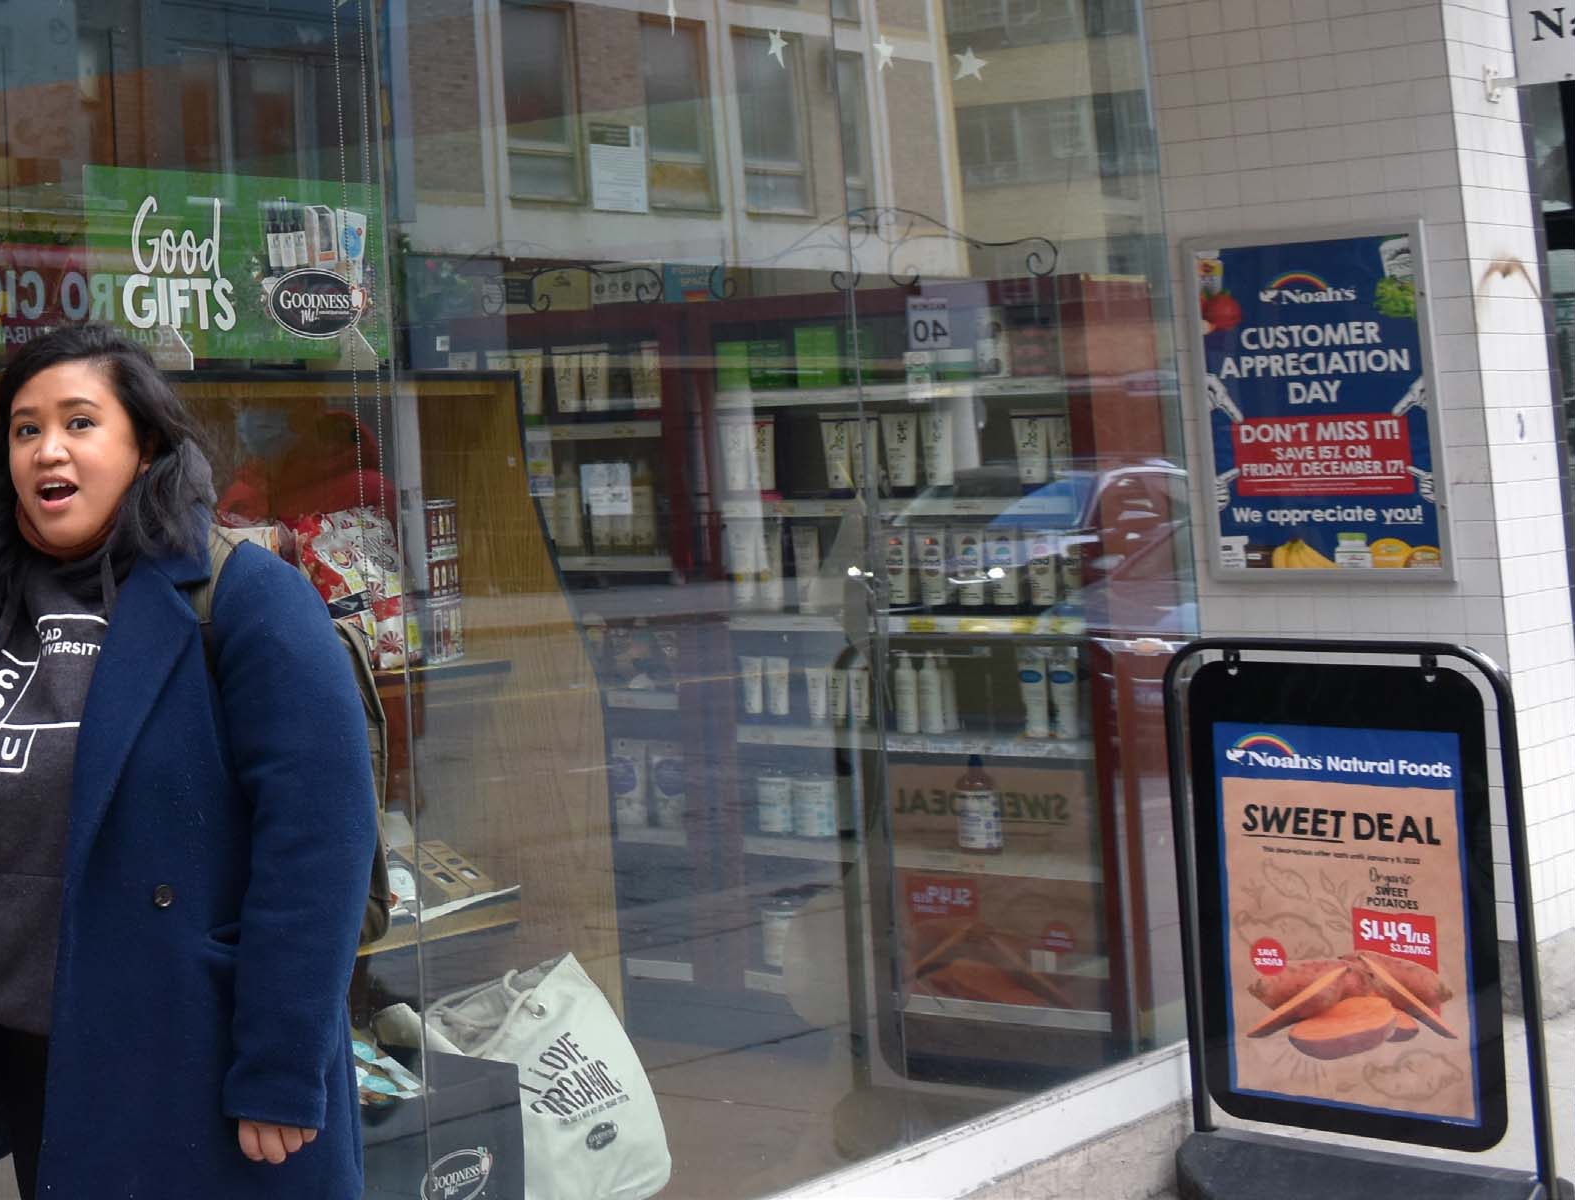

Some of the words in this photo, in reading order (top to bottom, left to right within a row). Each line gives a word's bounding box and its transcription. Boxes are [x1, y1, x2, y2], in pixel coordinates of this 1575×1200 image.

[132, 196, 221, 280] Good
[123, 273, 236, 331] GIFTS
[280, 291, 350, 309] GOODNESS
[1282, 286, 1356, 305] Noah's
[1240, 321, 1382, 350] CUSTOMER
[1219, 348, 1411, 379] APPRECIATION
[1287, 379, 1342, 405] DAY
[1240, 422, 1309, 444] DON'T
[1316, 421, 1369, 442] MISS
[1373, 419, 1401, 439] IT!
[1345, 445, 1371, 458] ON
[1301, 461, 1382, 476] DECEMBER
[1233, 507, 1263, 523] We
[1267, 505, 1377, 526] appreciate
[1382, 504, 1424, 524] you!
[1, 736, 21, 761] U
[1248, 750, 1323, 770] Noah's
[1327, 756, 1394, 775] Natural
[1399, 760, 1452, 778] Foods
[1242, 804, 1346, 838] SWEET
[1353, 812, 1441, 846] DEAL
[1367, 897, 1419, 910] POTATOES
[1375, 886, 1409, 898] SWEET
[528, 1032, 588, 1080] LOVE
